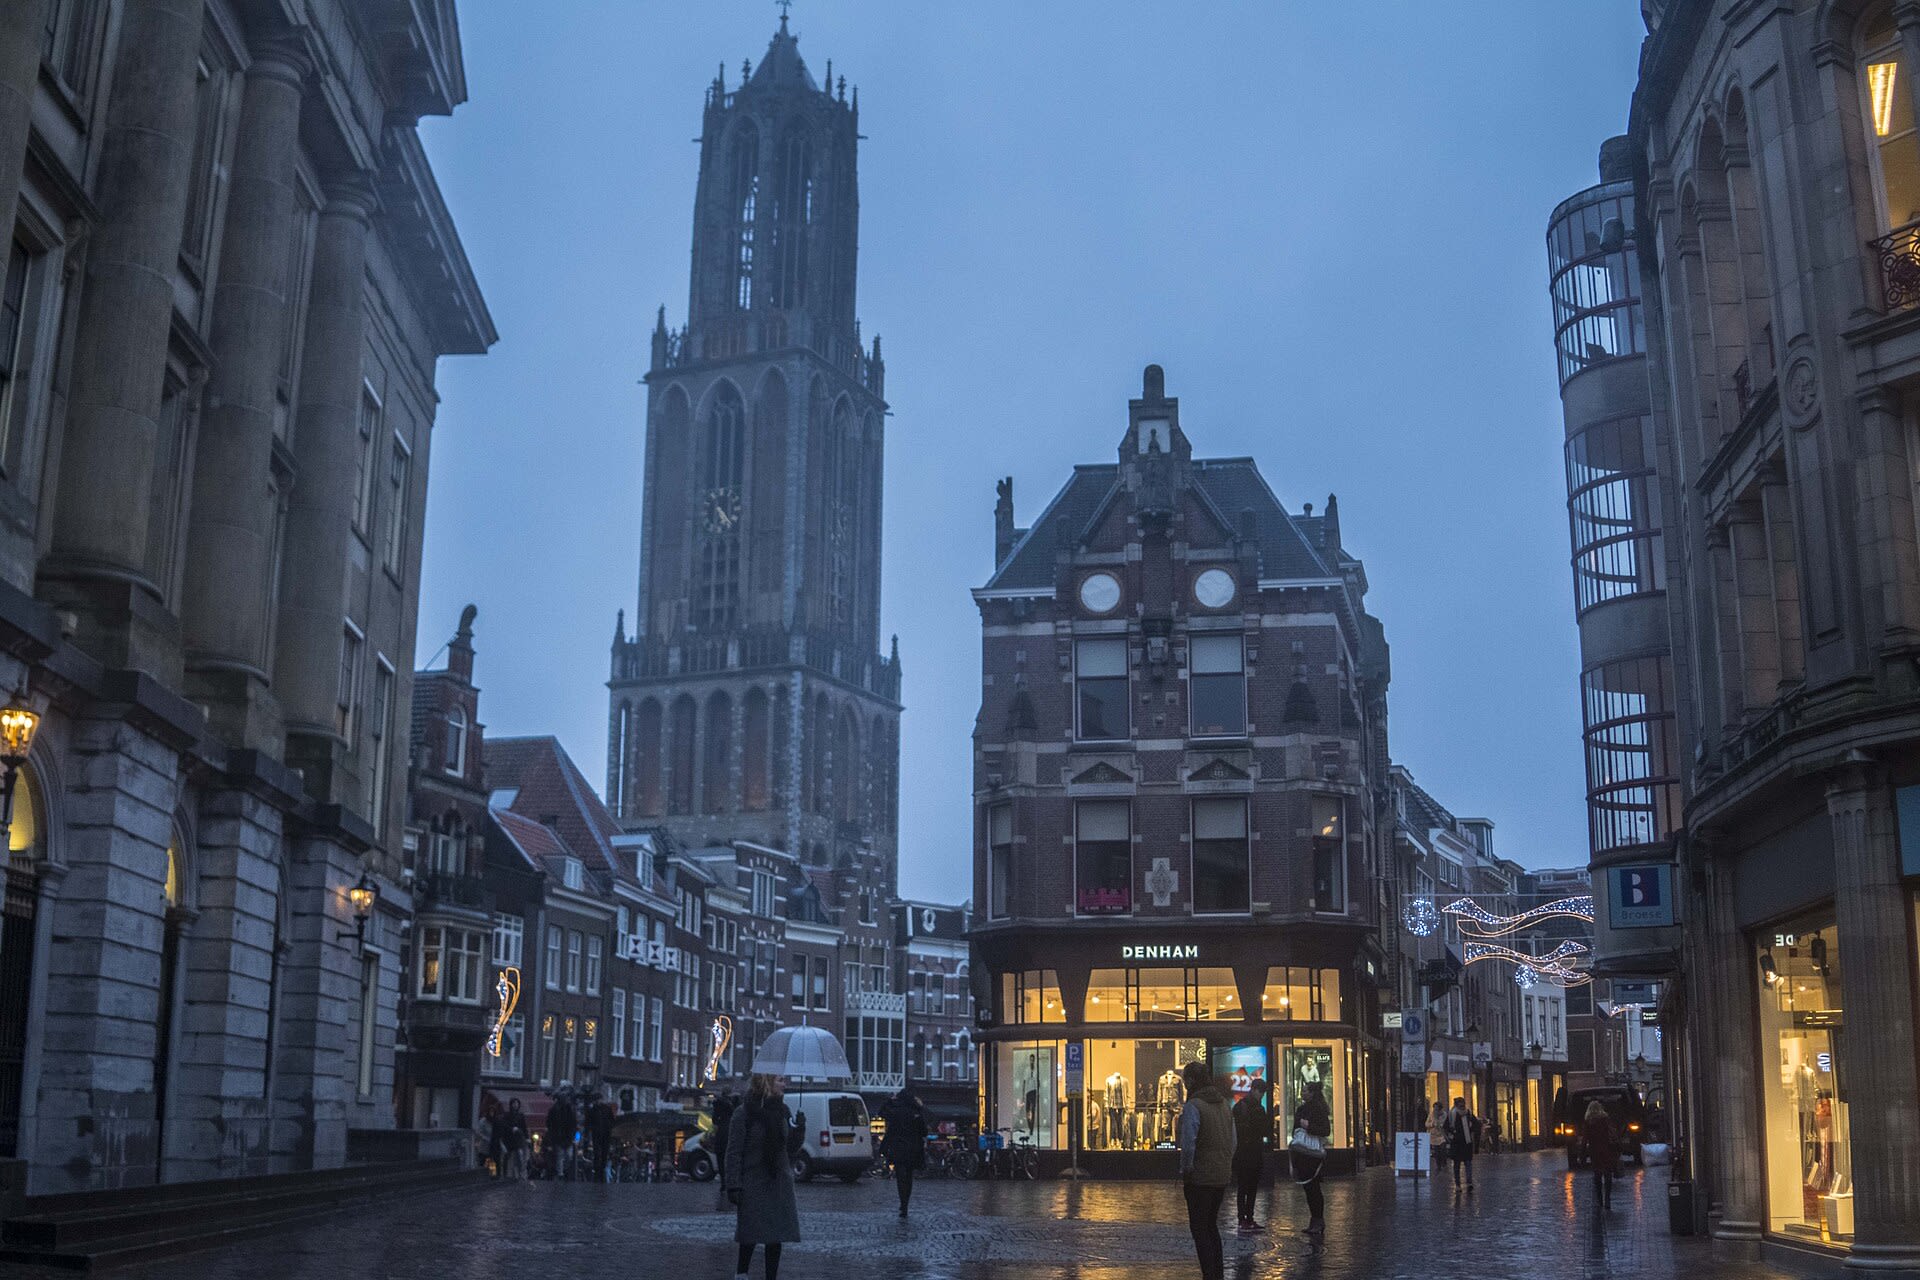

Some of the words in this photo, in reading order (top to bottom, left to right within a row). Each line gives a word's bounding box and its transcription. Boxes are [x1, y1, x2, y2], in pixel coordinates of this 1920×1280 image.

[1122, 945, 1198, 958] DENHAM
[1069, 1046, 1080, 1060] P
[1230, 1074, 1252, 1092] 22
